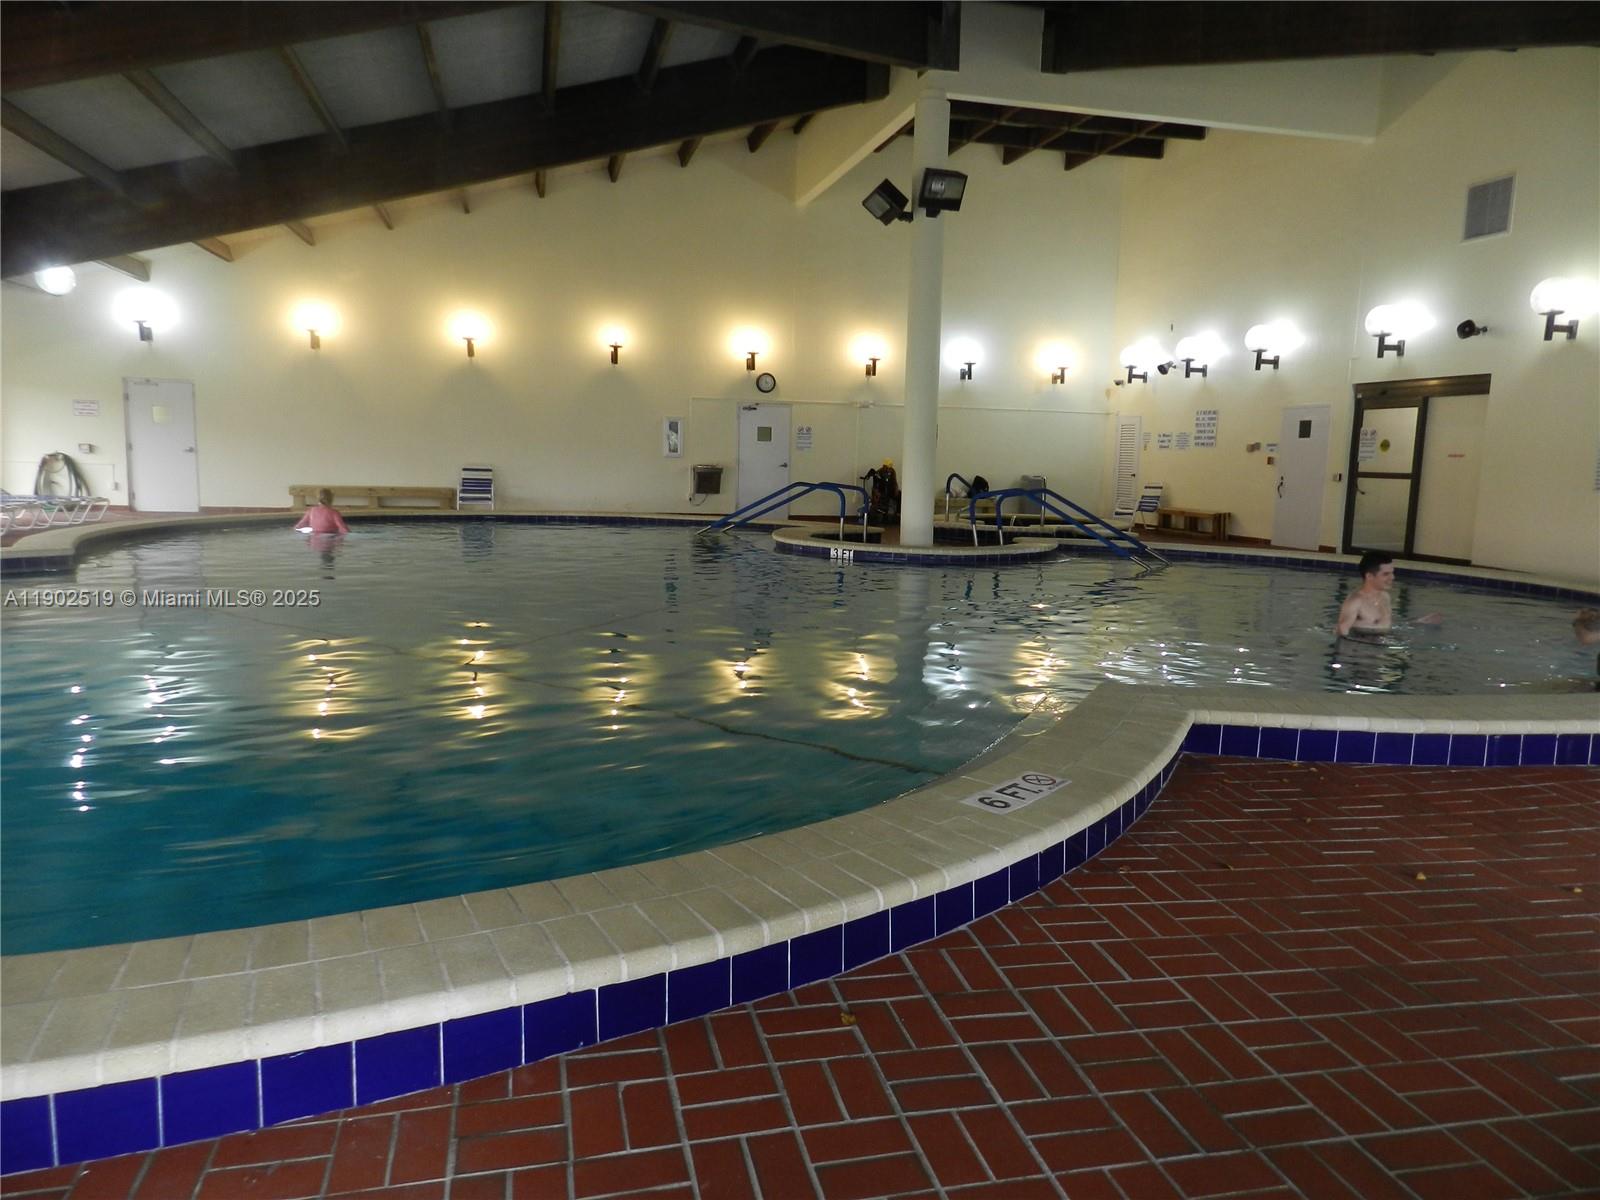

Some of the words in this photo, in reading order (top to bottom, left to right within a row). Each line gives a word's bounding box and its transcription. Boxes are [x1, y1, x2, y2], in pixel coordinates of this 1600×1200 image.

[833, 548, 839, 559] 3
[842, 549, 853, 560] FT
[977, 796, 1012, 809] 6
